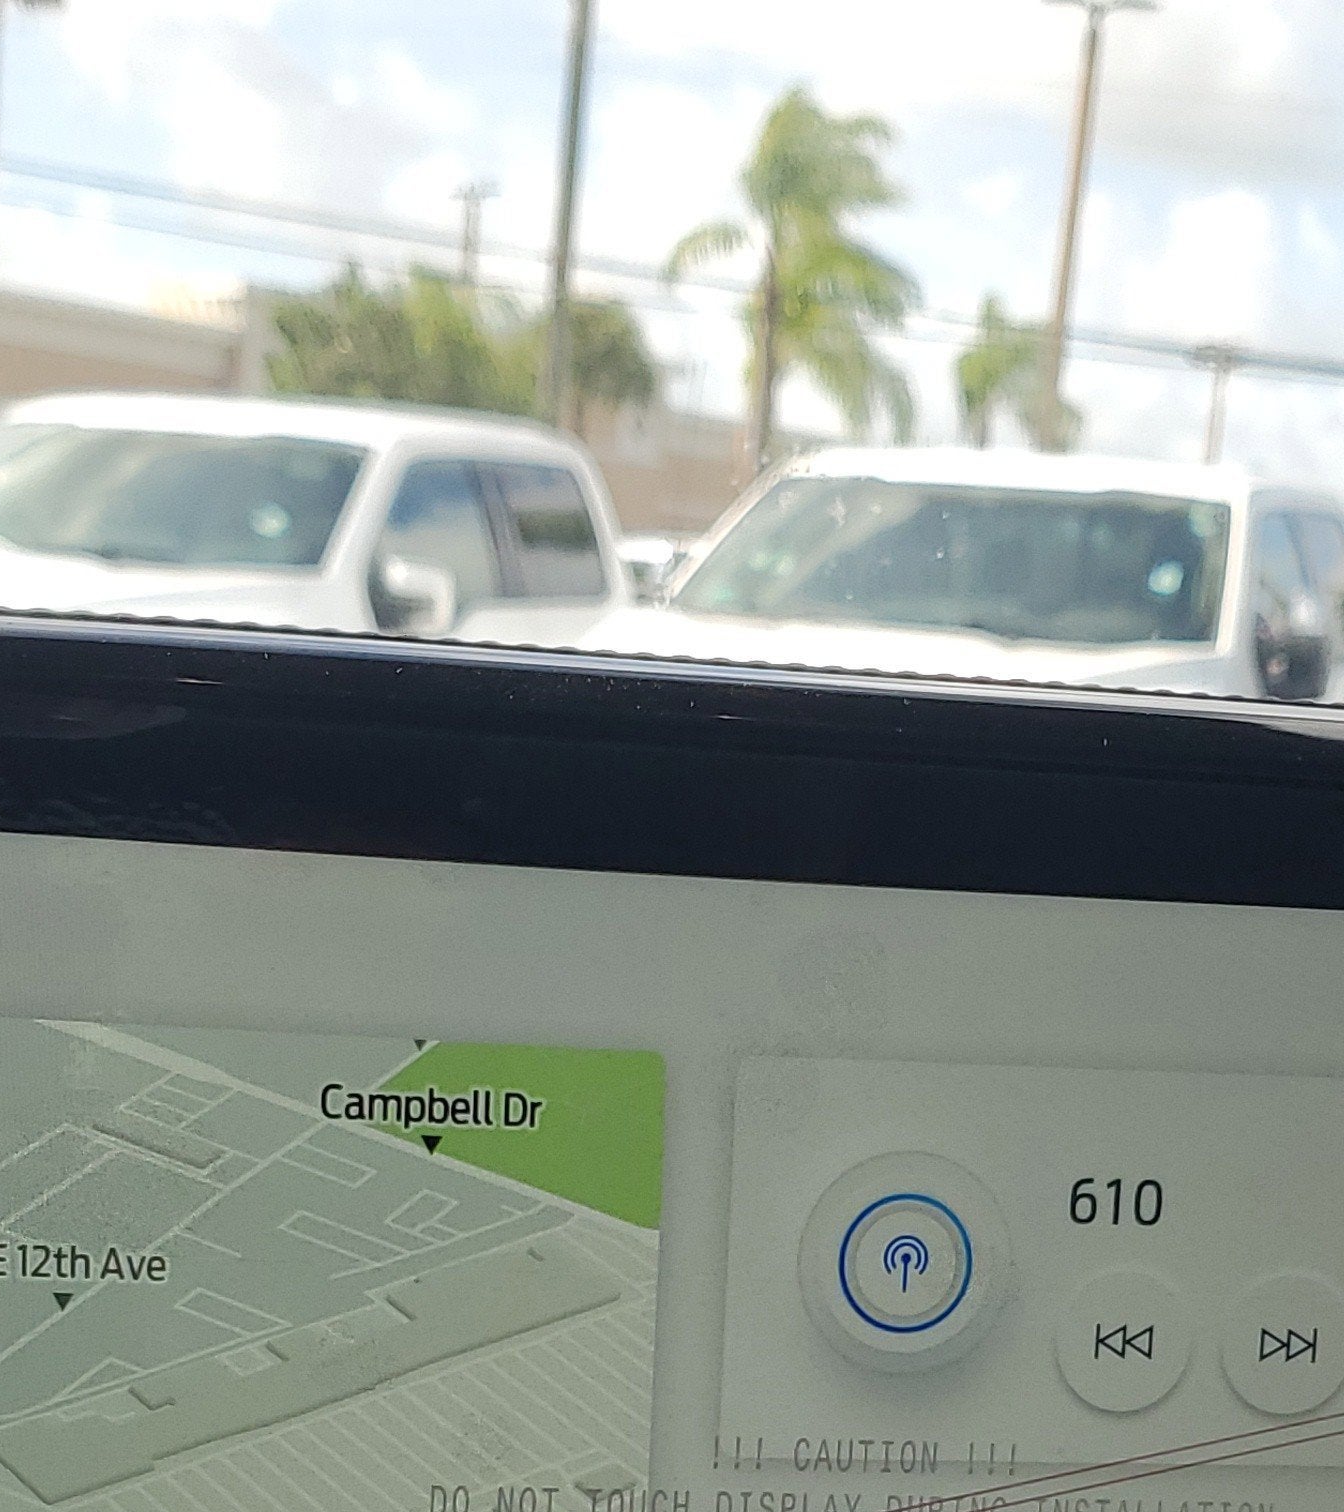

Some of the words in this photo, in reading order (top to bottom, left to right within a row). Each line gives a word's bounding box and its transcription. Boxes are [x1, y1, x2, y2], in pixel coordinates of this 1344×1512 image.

[321, 1083, 493, 1128] Campbell
[503, 1094, 543, 1128] Dr
[1069, 1177, 1164, 1226] 610
[17, 1245, 90, 1280] 12th
[100, 1248, 167, 1282] Ave
[793, 1437, 938, 1474] CAUTION
